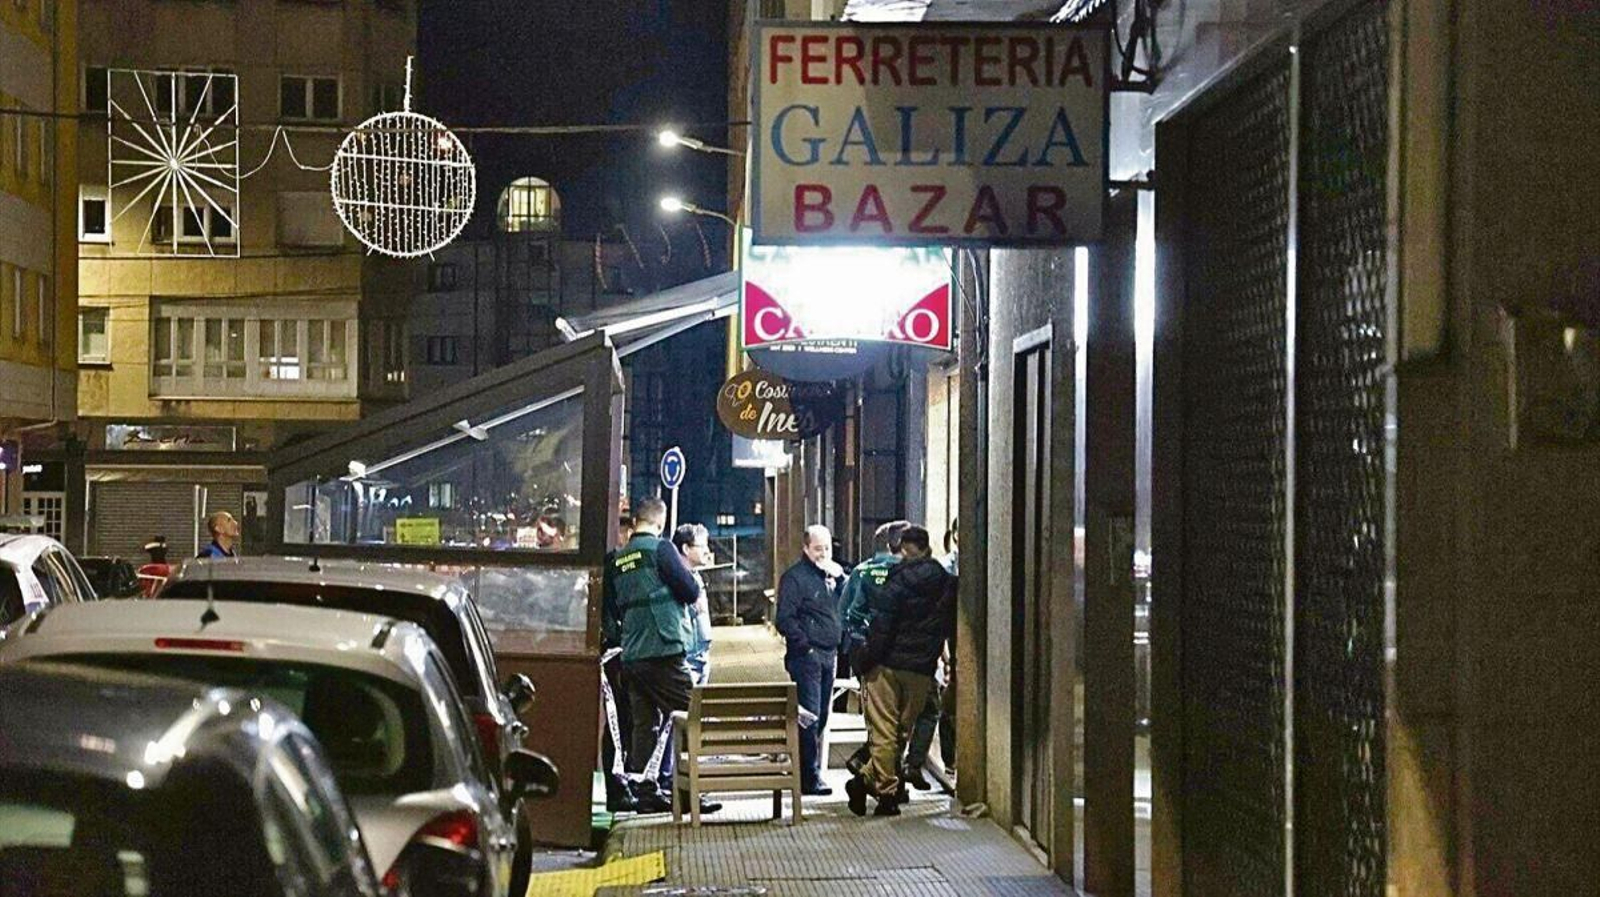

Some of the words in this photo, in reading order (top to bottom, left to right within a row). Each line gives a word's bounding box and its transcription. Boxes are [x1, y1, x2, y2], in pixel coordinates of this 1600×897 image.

[769, 34, 1094, 88] FERRETERIA
[770, 104, 1089, 167] GALIZA
[793, 183, 1068, 235] BAZAR
[739, 403, 757, 420] de
